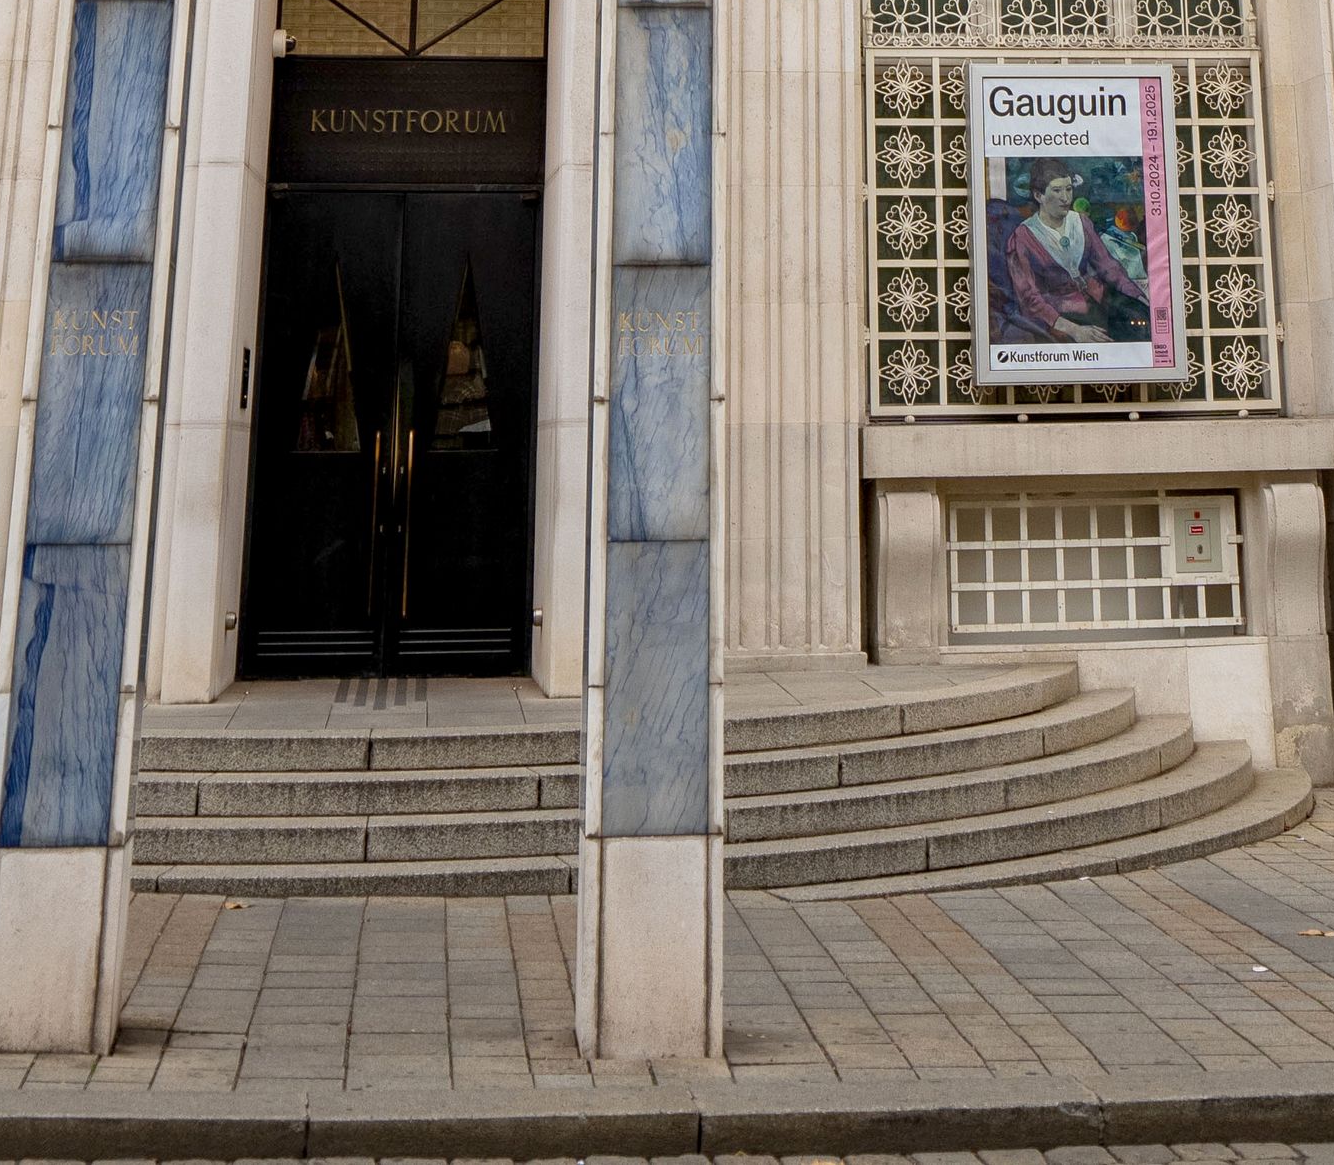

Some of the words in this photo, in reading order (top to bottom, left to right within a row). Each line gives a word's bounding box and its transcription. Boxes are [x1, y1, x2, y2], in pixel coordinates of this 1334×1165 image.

[990, 86, 1126, 124] Gauguin
[1145, 85, 1157, 141] 19.1.2025
[310, 109, 506, 133] KUNSTFORUM
[992, 130, 1089, 149] unexpected
[1149, 155, 1161, 215] 3.10.2024
[52, 309, 139, 330] KUNST
[618, 309, 700, 331] KUNST
[50, 334, 139, 356] FORUM
[619, 334, 703, 356] FORUM
[1011, 351, 1069, 362] Kunstforum
[1073, 350, 1098, 361] Wien
